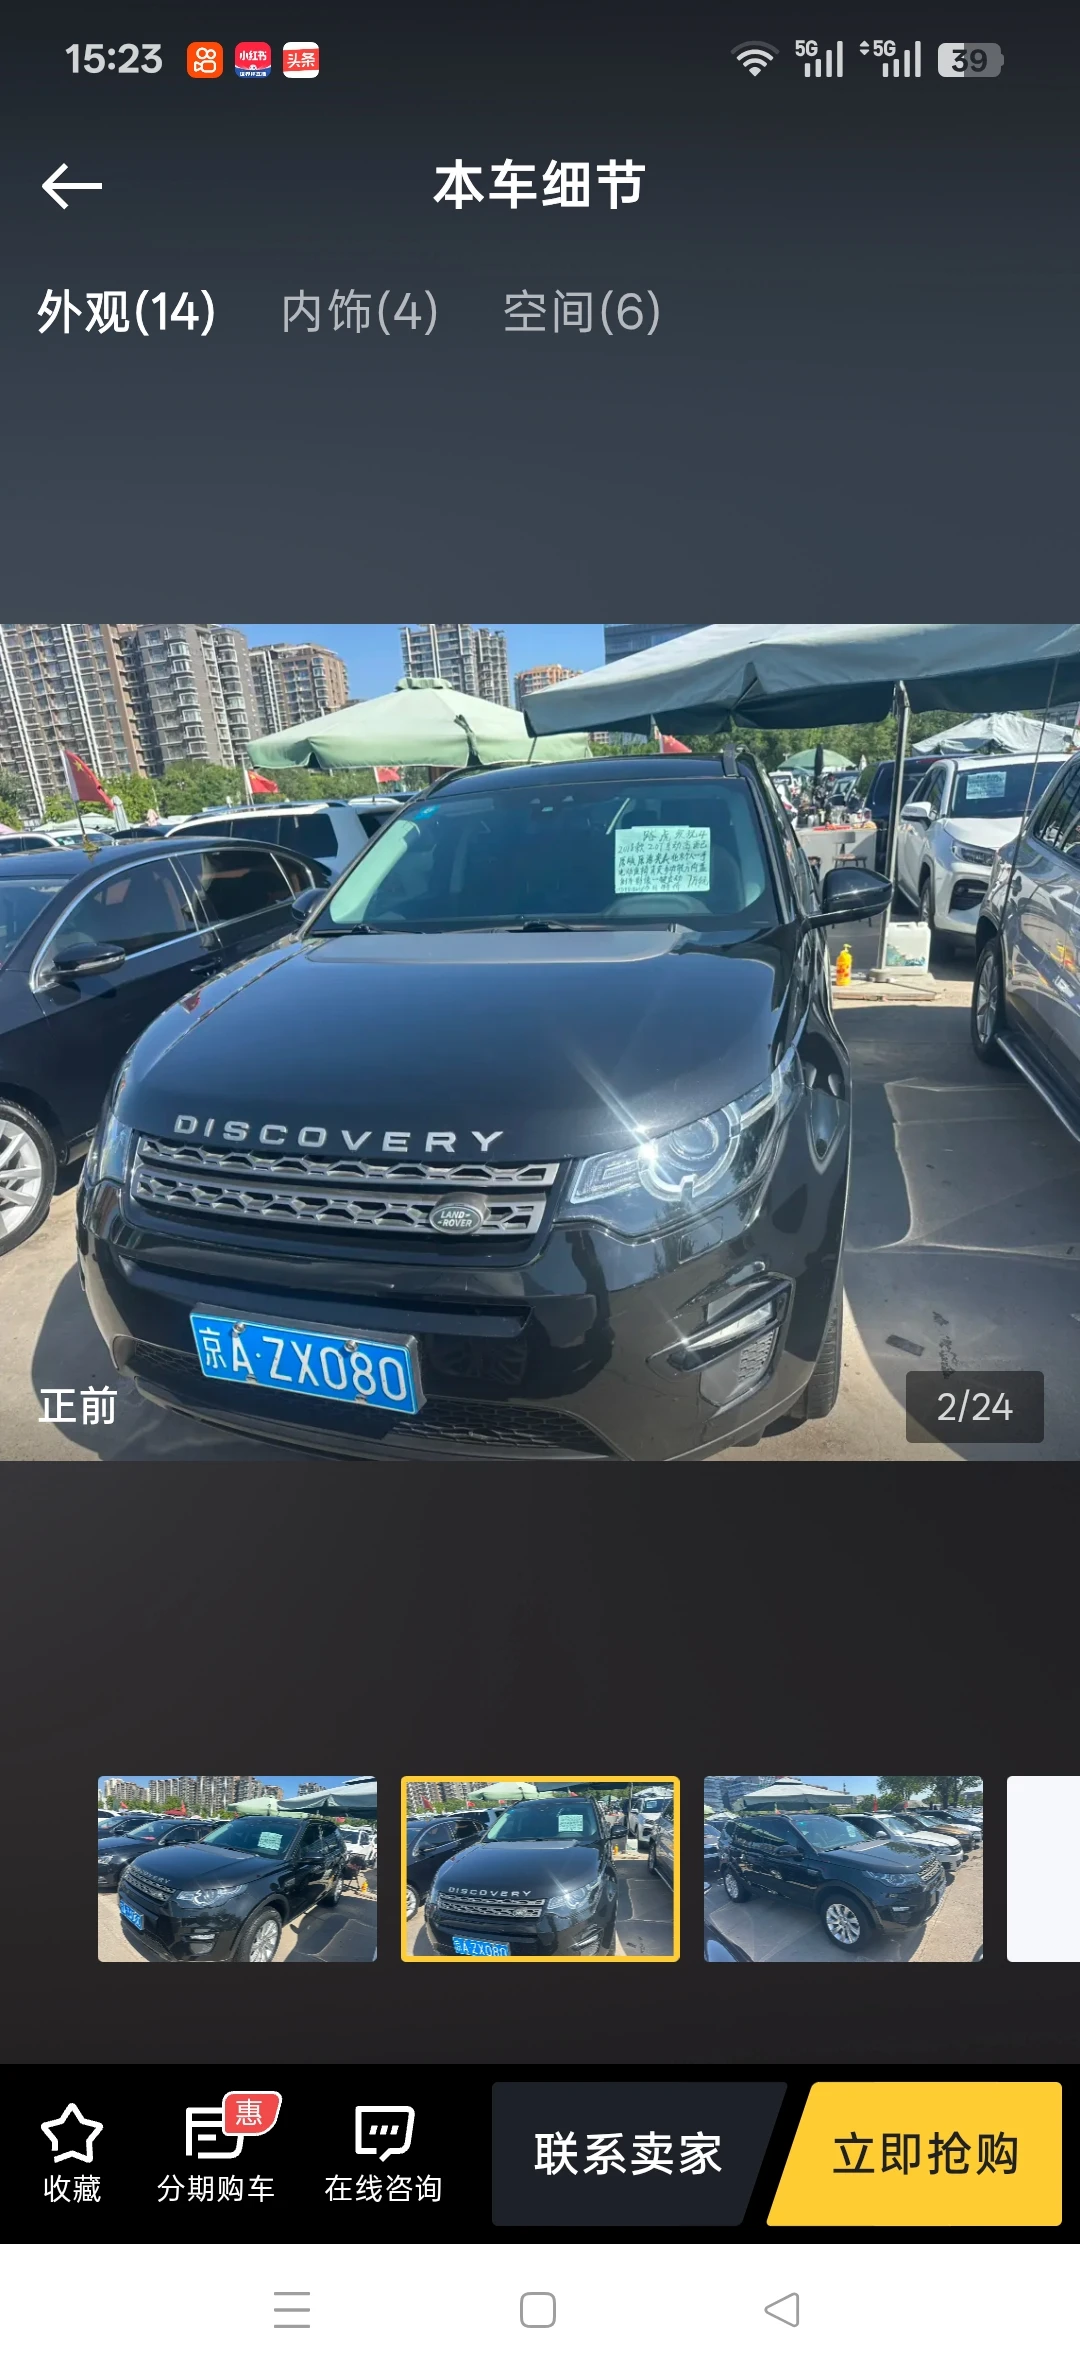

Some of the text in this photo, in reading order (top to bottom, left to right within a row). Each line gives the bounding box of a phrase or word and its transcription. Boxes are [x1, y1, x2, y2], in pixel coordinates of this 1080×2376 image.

[66, 43, 162, 73] 15:23
[240, 51, 267, 61] 小红书
[287, 52, 316, 69] 头条
[795, 40, 818, 56] 5G
[873, 40, 897, 56] 5G
[951, 48, 988, 72] 39
[433, 158, 645, 210] 本车细节
[37, 289, 661, 336] 外观(14) 内饰(4) 空间(6)
[172, 1114, 505, 1154] DISCOVERY
[440, 1210, 466, 1219] LAND
[442, 1218, 473, 1228] ROVER
[447, 1886, 532, 1898] DISCOVERY
[235, 2098, 263, 2126] 惠
[534, 2130, 723, 2176] 联系卖家
[832, 2130, 1020, 2176] 立即抢购
[43, 2173, 443, 2204] 收藏 分期购车 在线咨询
